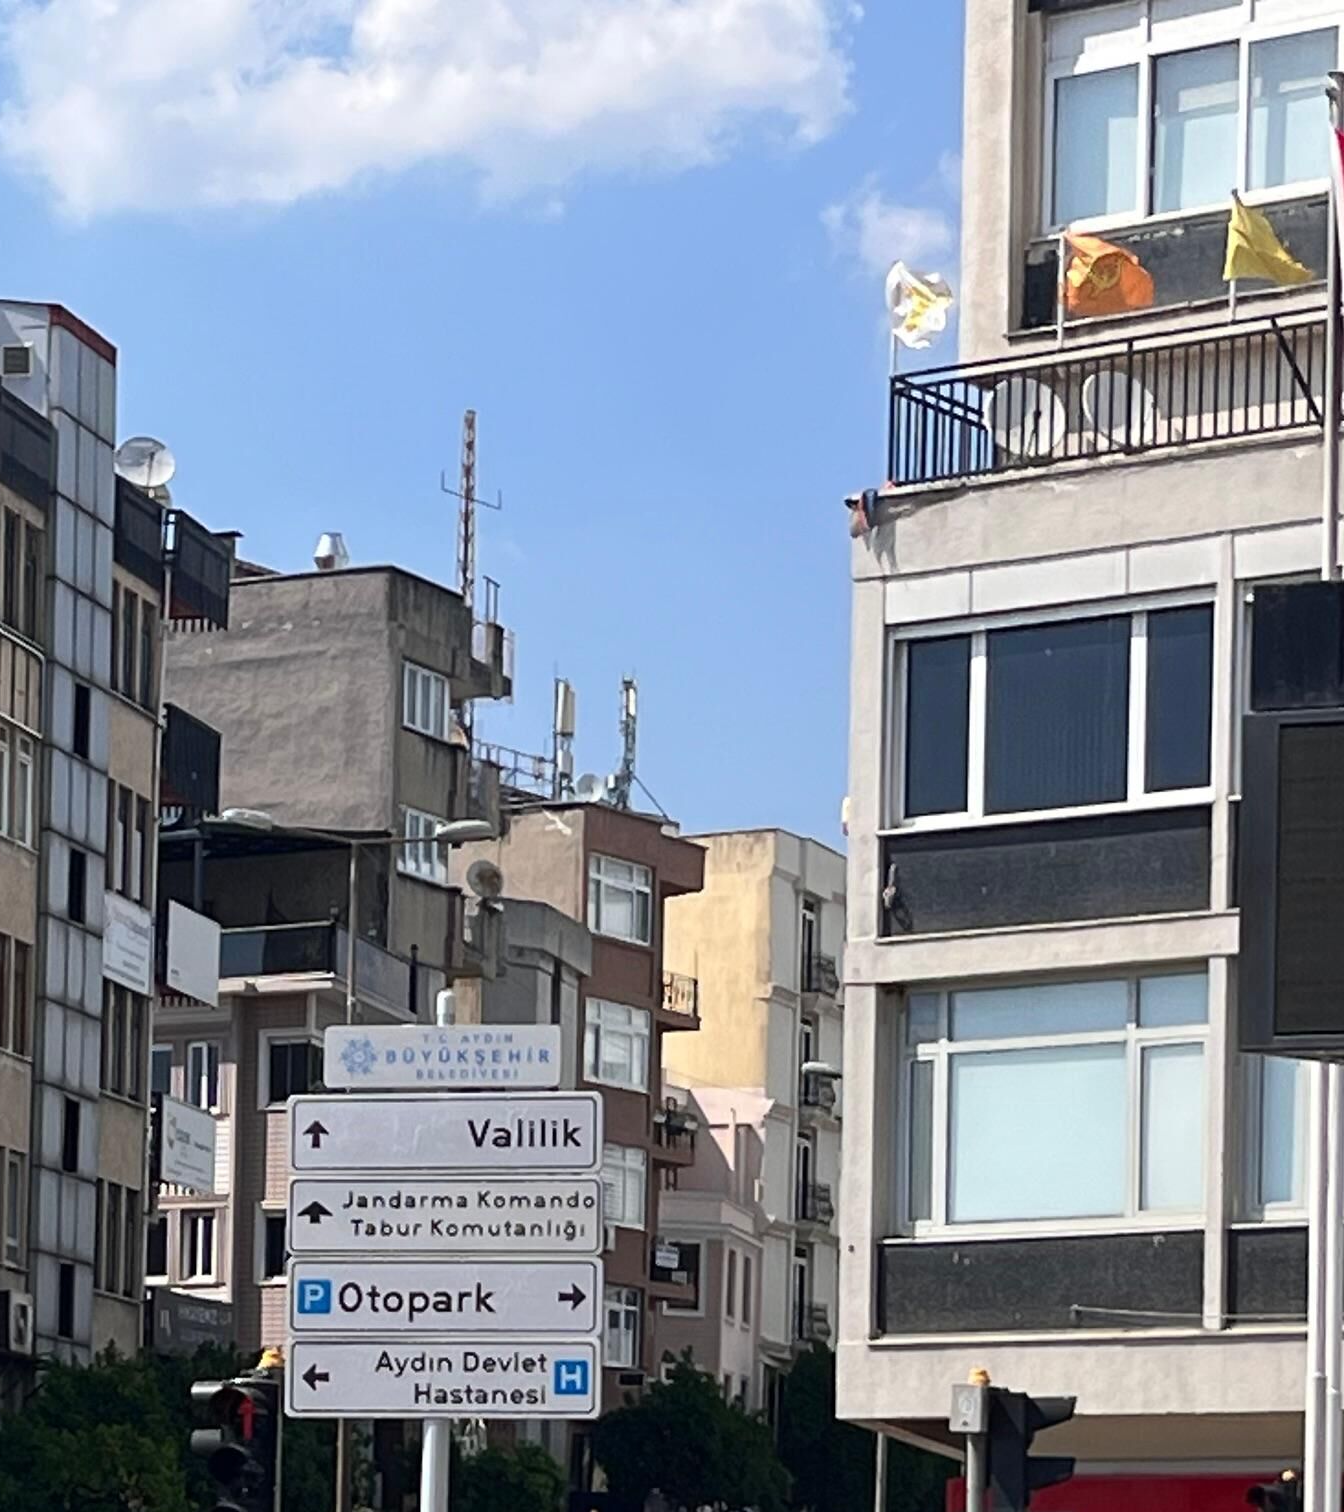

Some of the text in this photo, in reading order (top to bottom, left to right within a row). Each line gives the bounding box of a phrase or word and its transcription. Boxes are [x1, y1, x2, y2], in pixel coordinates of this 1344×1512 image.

[460, 1033, 514, 1044] AYDIN
[385, 1045, 551, 1066] BÜYÜKŞEHİR
[415, 1066, 520, 1081] BELEDİYESİ
[467, 1118, 582, 1149] Valilik
[342, 1191, 596, 1210] Jandarma Komando
[351, 1218, 586, 1241] Tabur Komutanlığı
[338, 1282, 497, 1323] Otopark
[375, 1350, 548, 1380] Aydın Devlet
[413, 1383, 546, 1405] Hastanesi
